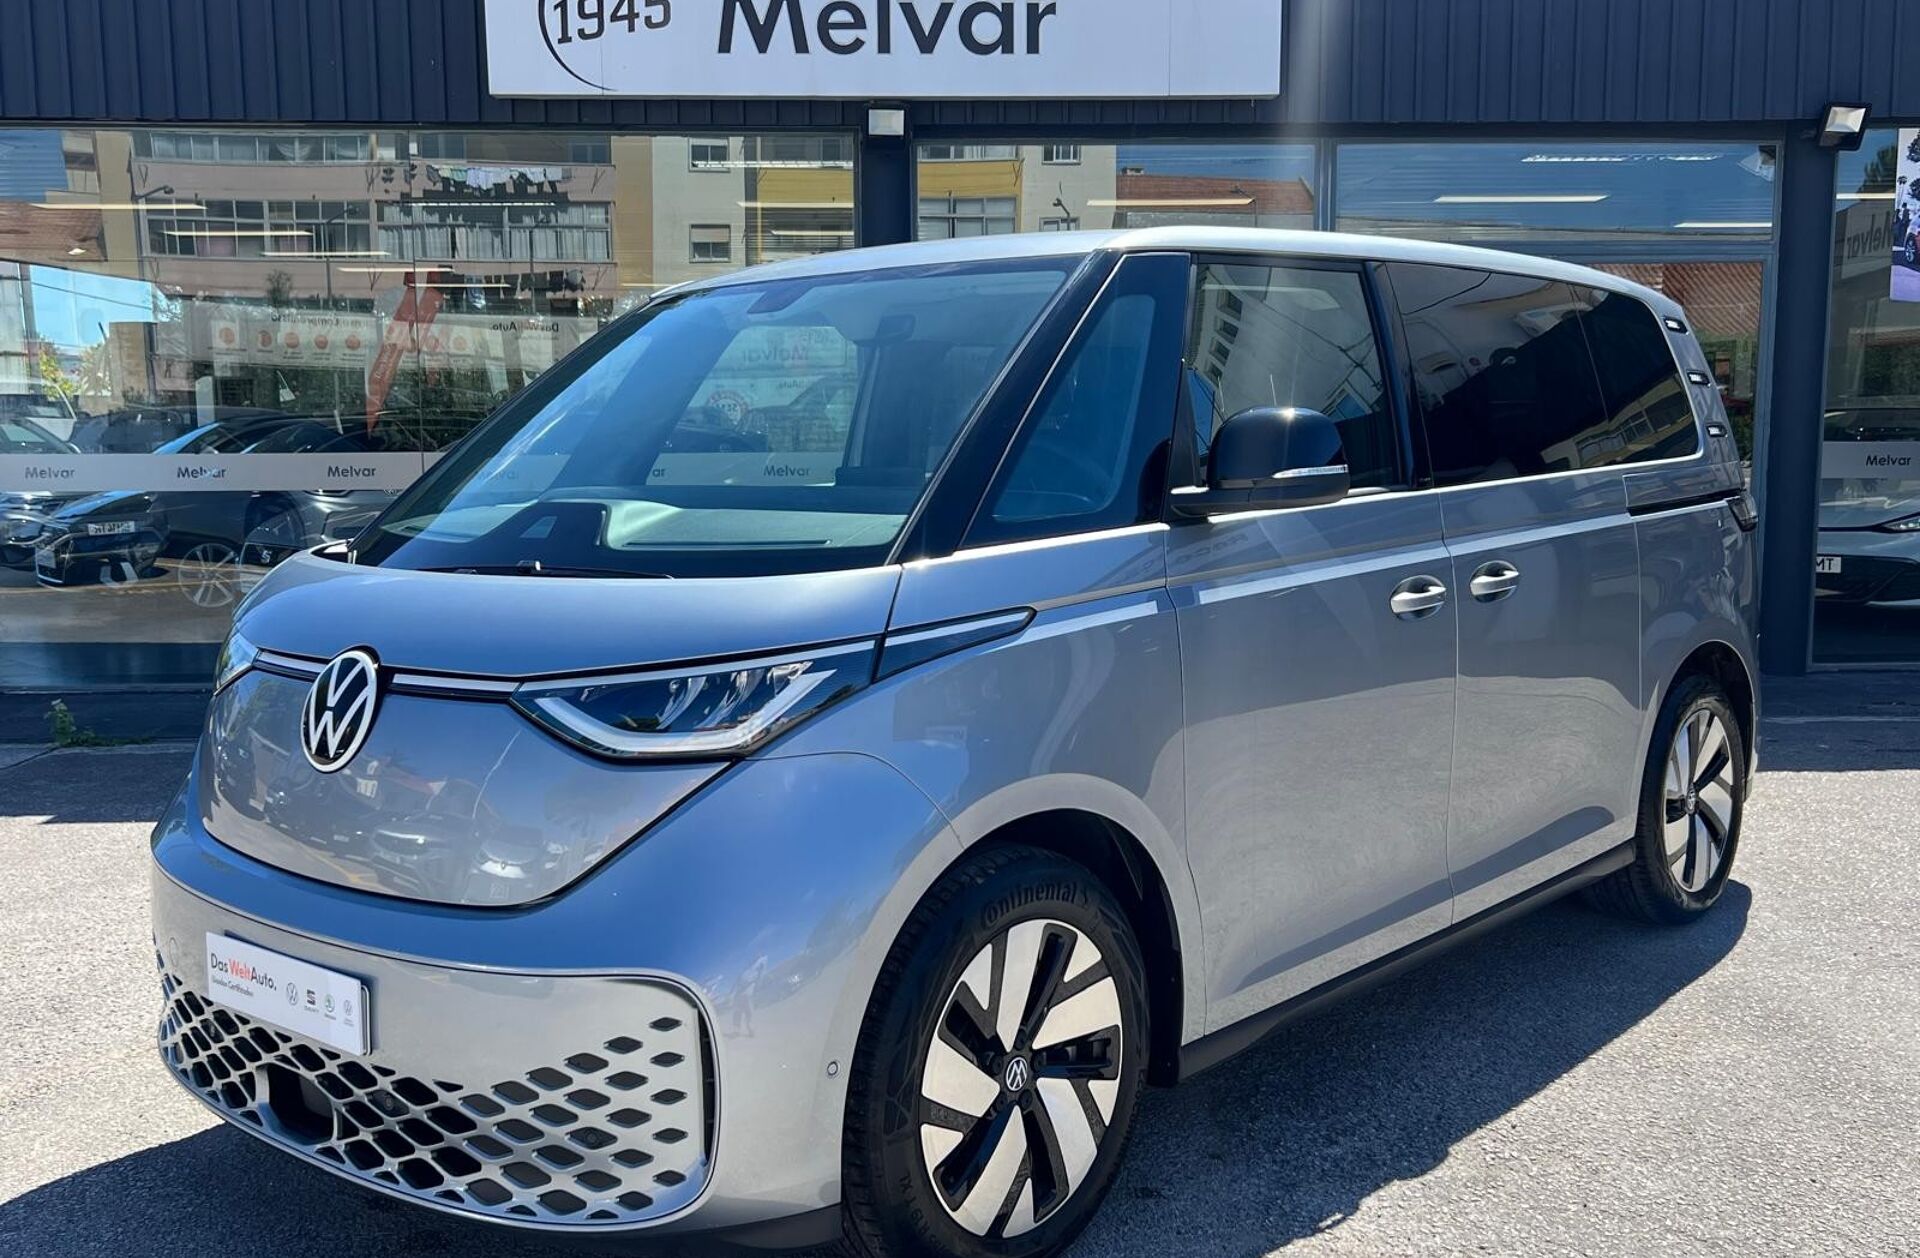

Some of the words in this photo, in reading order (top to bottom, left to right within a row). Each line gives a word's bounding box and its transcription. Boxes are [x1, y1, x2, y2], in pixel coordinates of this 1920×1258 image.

[553, 0, 671, 45] 1945
[717, 0, 1057, 55] Melvar
[1866, 454, 1911, 466] Melvar
[25, 466, 76, 479] Melvar
[177, 466, 227, 479] Melvar
[327, 465, 376, 478] Melvar
[763, 465, 810, 477] Melvar
[983, 881, 1078, 926] Continental
[210, 952, 228, 973] Das
